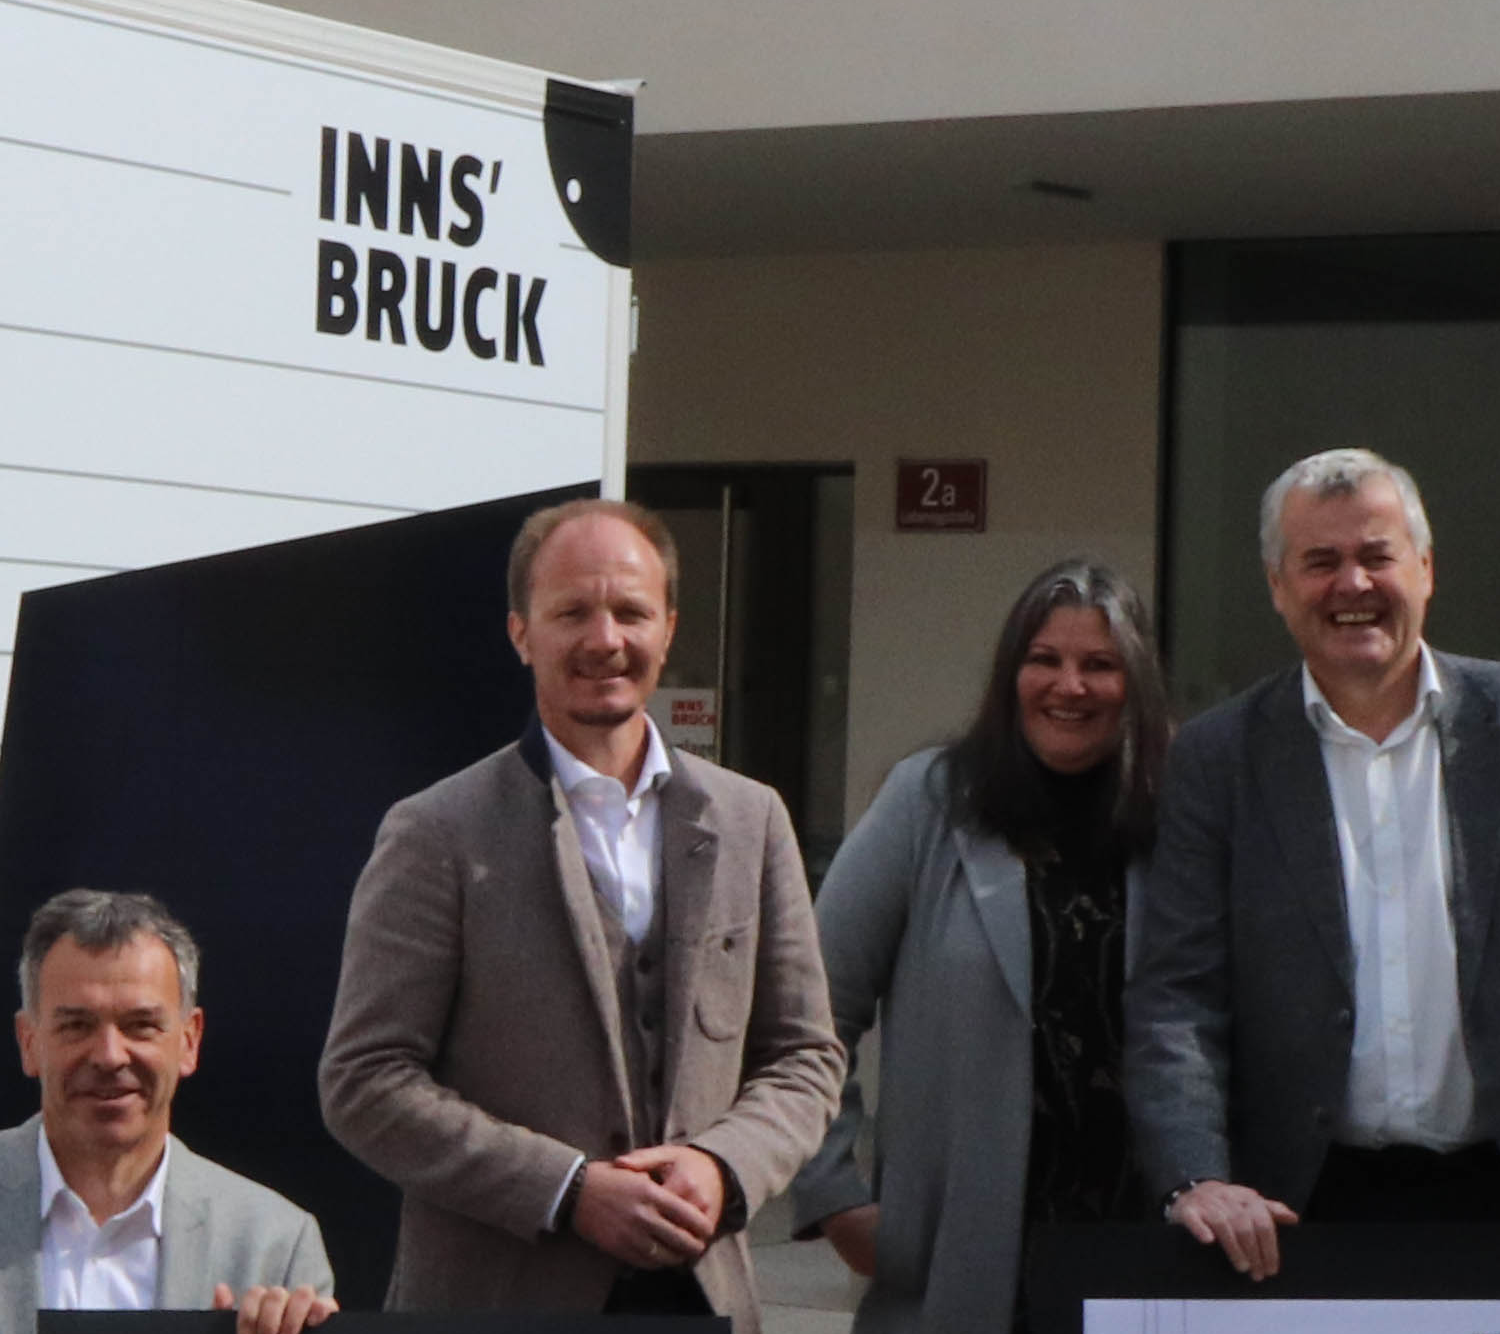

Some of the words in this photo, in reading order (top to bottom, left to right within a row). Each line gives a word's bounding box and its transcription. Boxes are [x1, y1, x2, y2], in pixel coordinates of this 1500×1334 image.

[319, 124, 503, 248] INNS'
[315, 238, 548, 368] BRUCK
[921, 467, 956, 507] 2a
